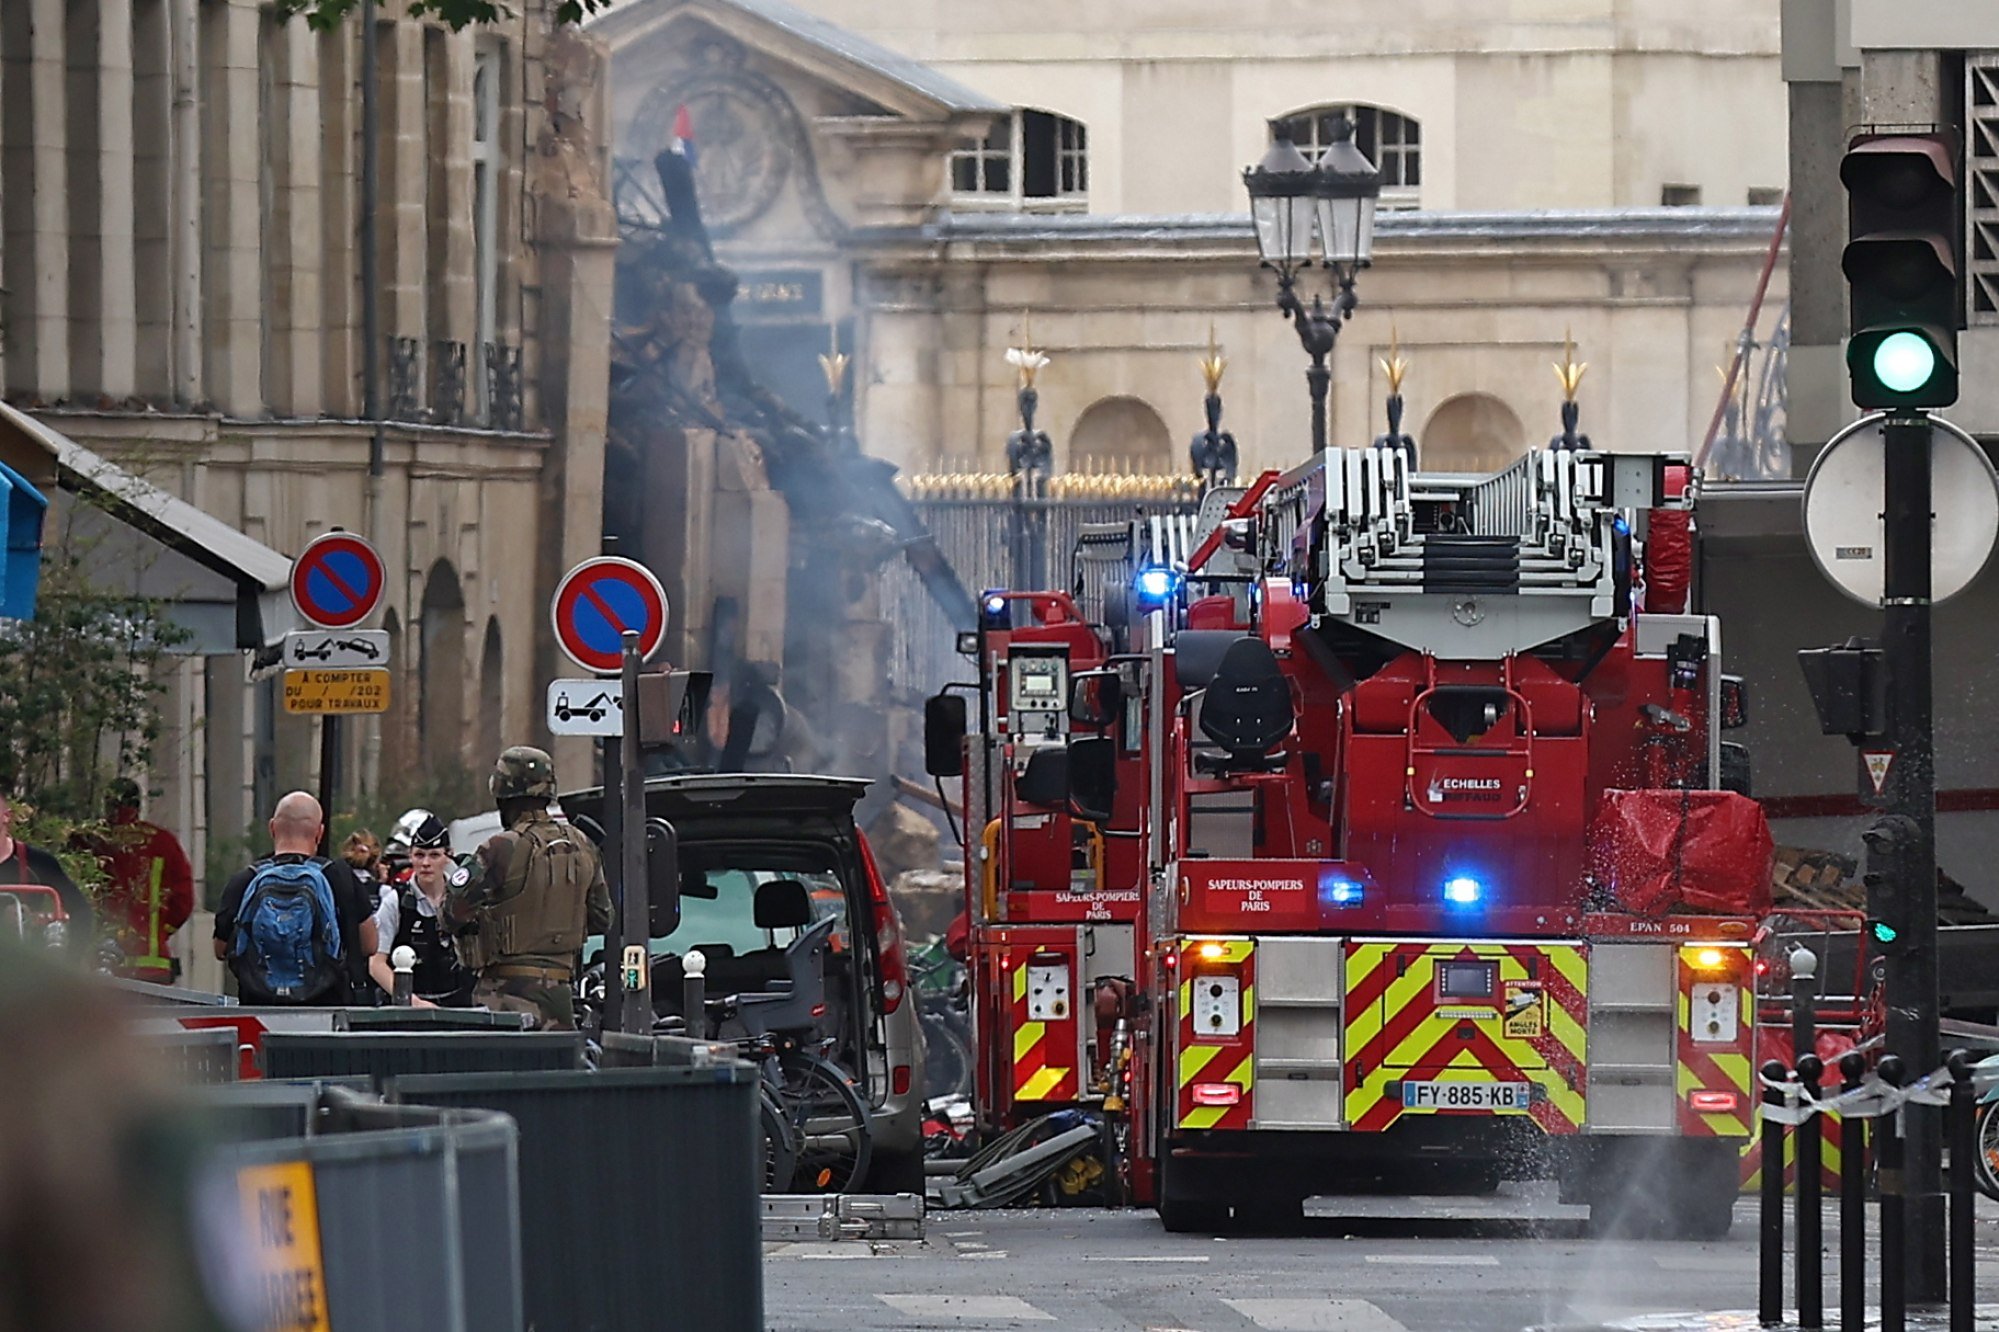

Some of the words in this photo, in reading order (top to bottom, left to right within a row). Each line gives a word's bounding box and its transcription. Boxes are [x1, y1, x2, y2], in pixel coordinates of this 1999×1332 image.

[315, 673, 371, 683] COMPTER
[286, 686, 302, 696] DU
[291, 699, 322, 709] POUR
[329, 699, 381, 709] TRAVAUX
[1443, 779, 1501, 789] ECHELLES
[1208, 880, 1304, 890] SAPEURS-POMPIERS
[1249, 891, 1263, 900] DE
[1092, 902, 1104, 911] DE
[1241, 901, 1270, 911] PARIS
[1086, 910, 1111, 920] PARIS
[1630, 922, 1662, 932] EPAN
[1669, 924, 1690, 933] 504
